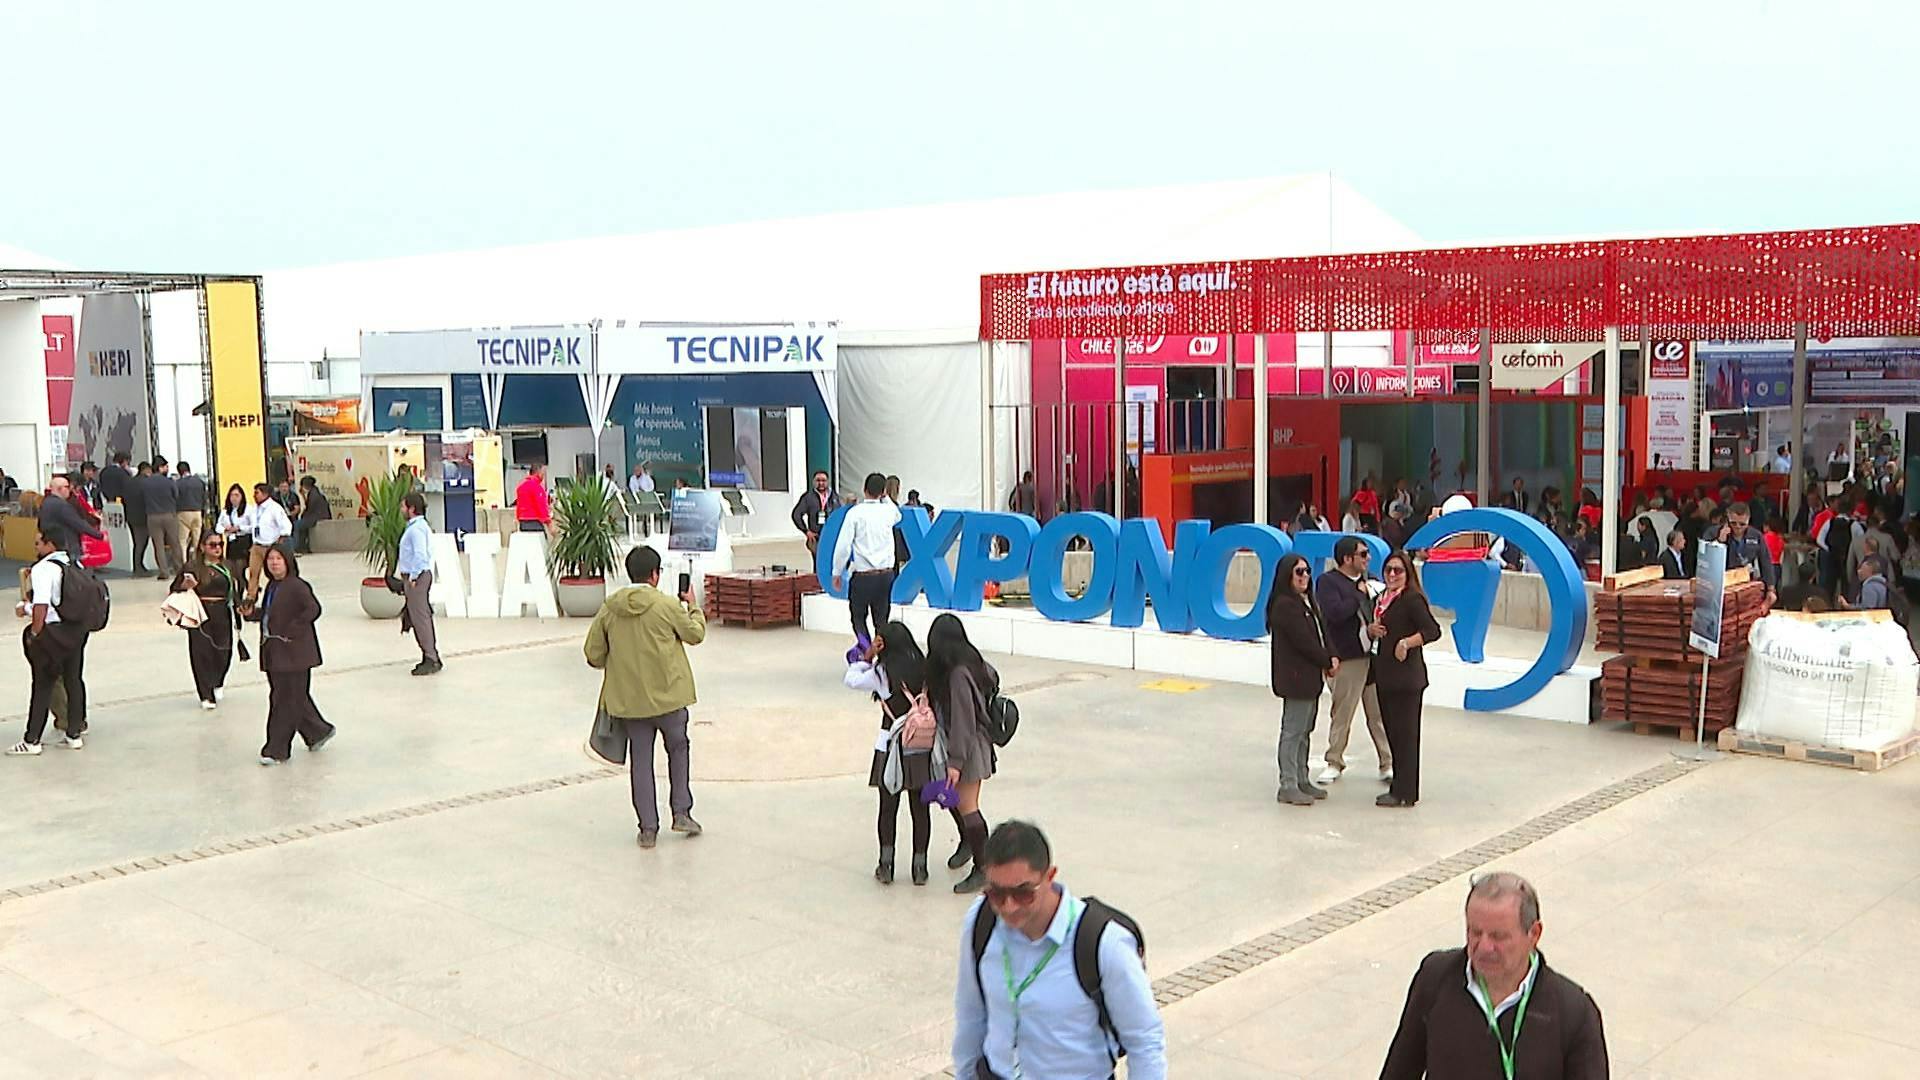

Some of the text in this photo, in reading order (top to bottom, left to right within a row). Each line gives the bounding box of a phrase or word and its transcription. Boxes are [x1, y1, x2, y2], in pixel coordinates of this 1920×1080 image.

[1027, 272, 1046, 298] El
[1050, 272, 1119, 297] futuro
[1123, 266, 1174, 295] está
[1055, 302, 1131, 318] sucediendo
[476, 336, 581, 366] TECNIPAK
[666, 335, 825, 364] TECNIPAK
[1080, 338, 1144, 354] CHILE 26
[99, 349, 132, 376] KEPI
[1501, 349, 1564, 368] cefomin
[1375, 374, 1442, 391] INFORMCIONES
[651, 401, 674, 415] horas
[228, 414, 261, 428] KEPI
[635, 434, 661, 446] Menos
[1272, 428, 1294, 445] BHP
[1762, 660, 1809, 679] ONATO
